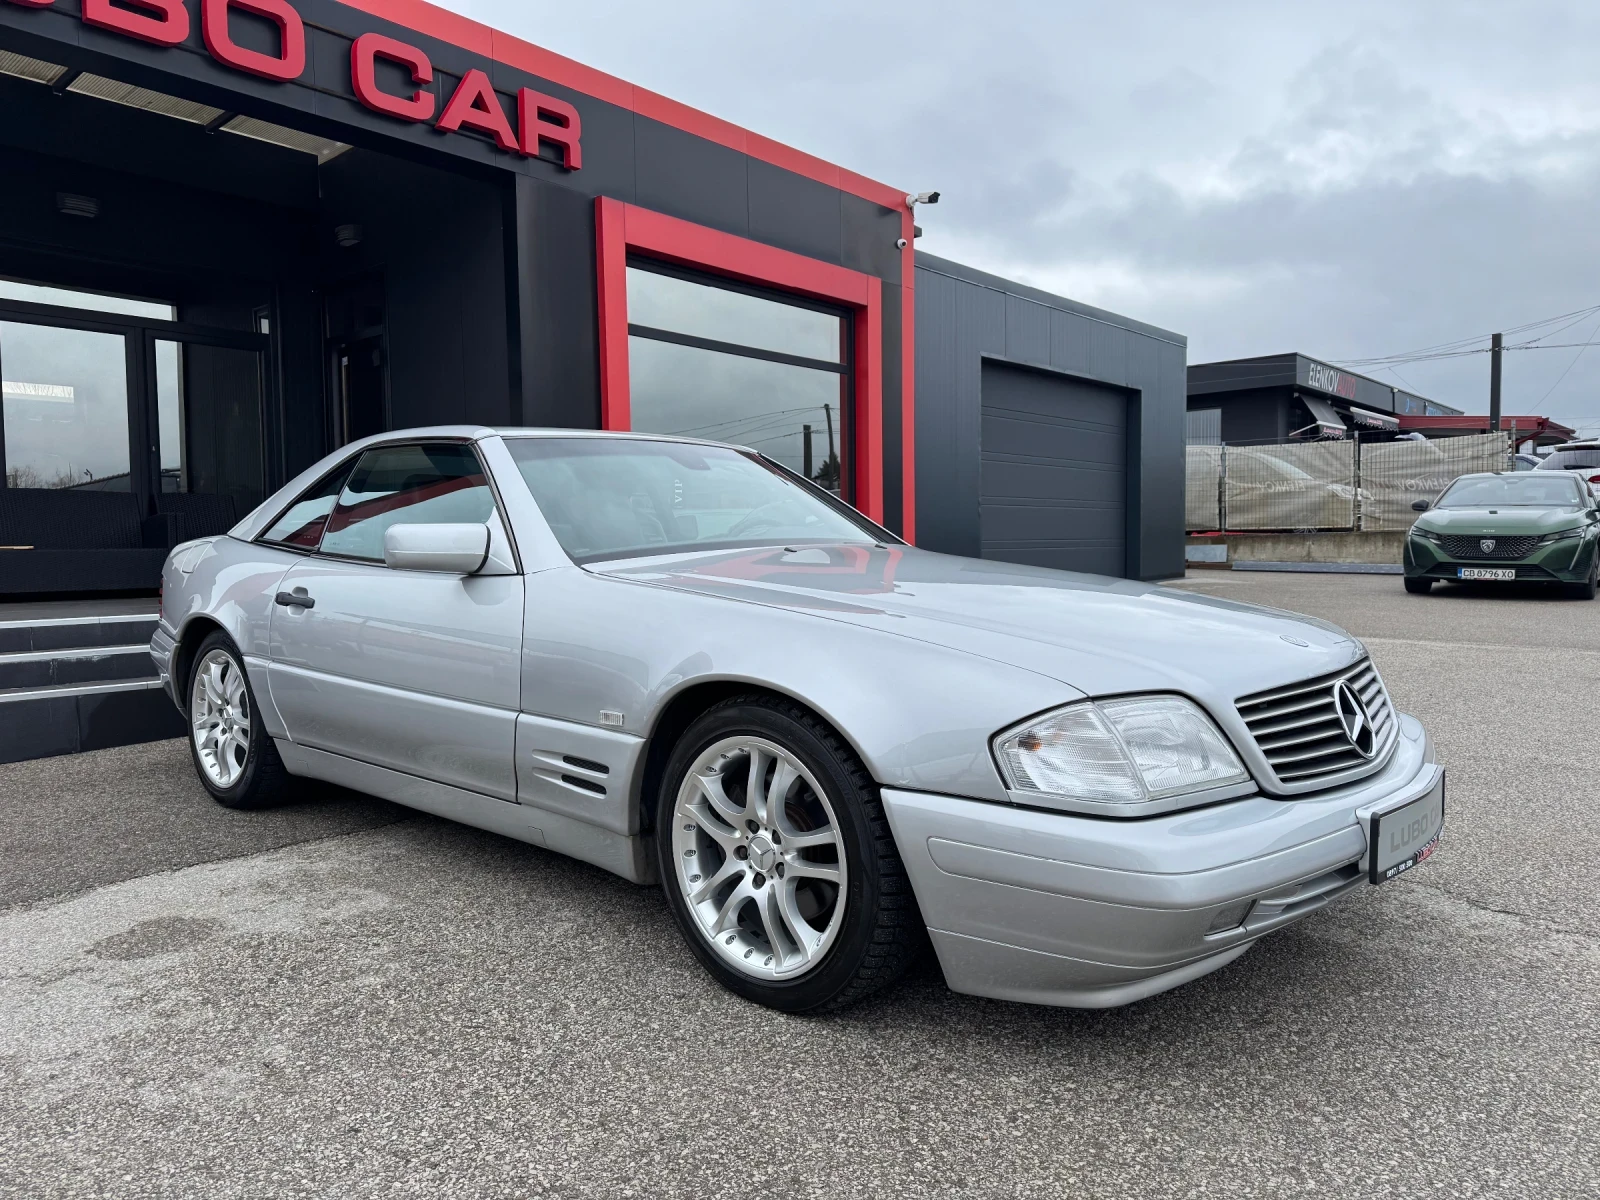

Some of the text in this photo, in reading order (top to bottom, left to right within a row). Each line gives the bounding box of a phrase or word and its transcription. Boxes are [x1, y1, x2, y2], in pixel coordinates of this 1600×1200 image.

[351, 32, 582, 171] CAR
[1477, 569, 1499, 578] 8796
[1390, 813, 1429, 853] LUBO
